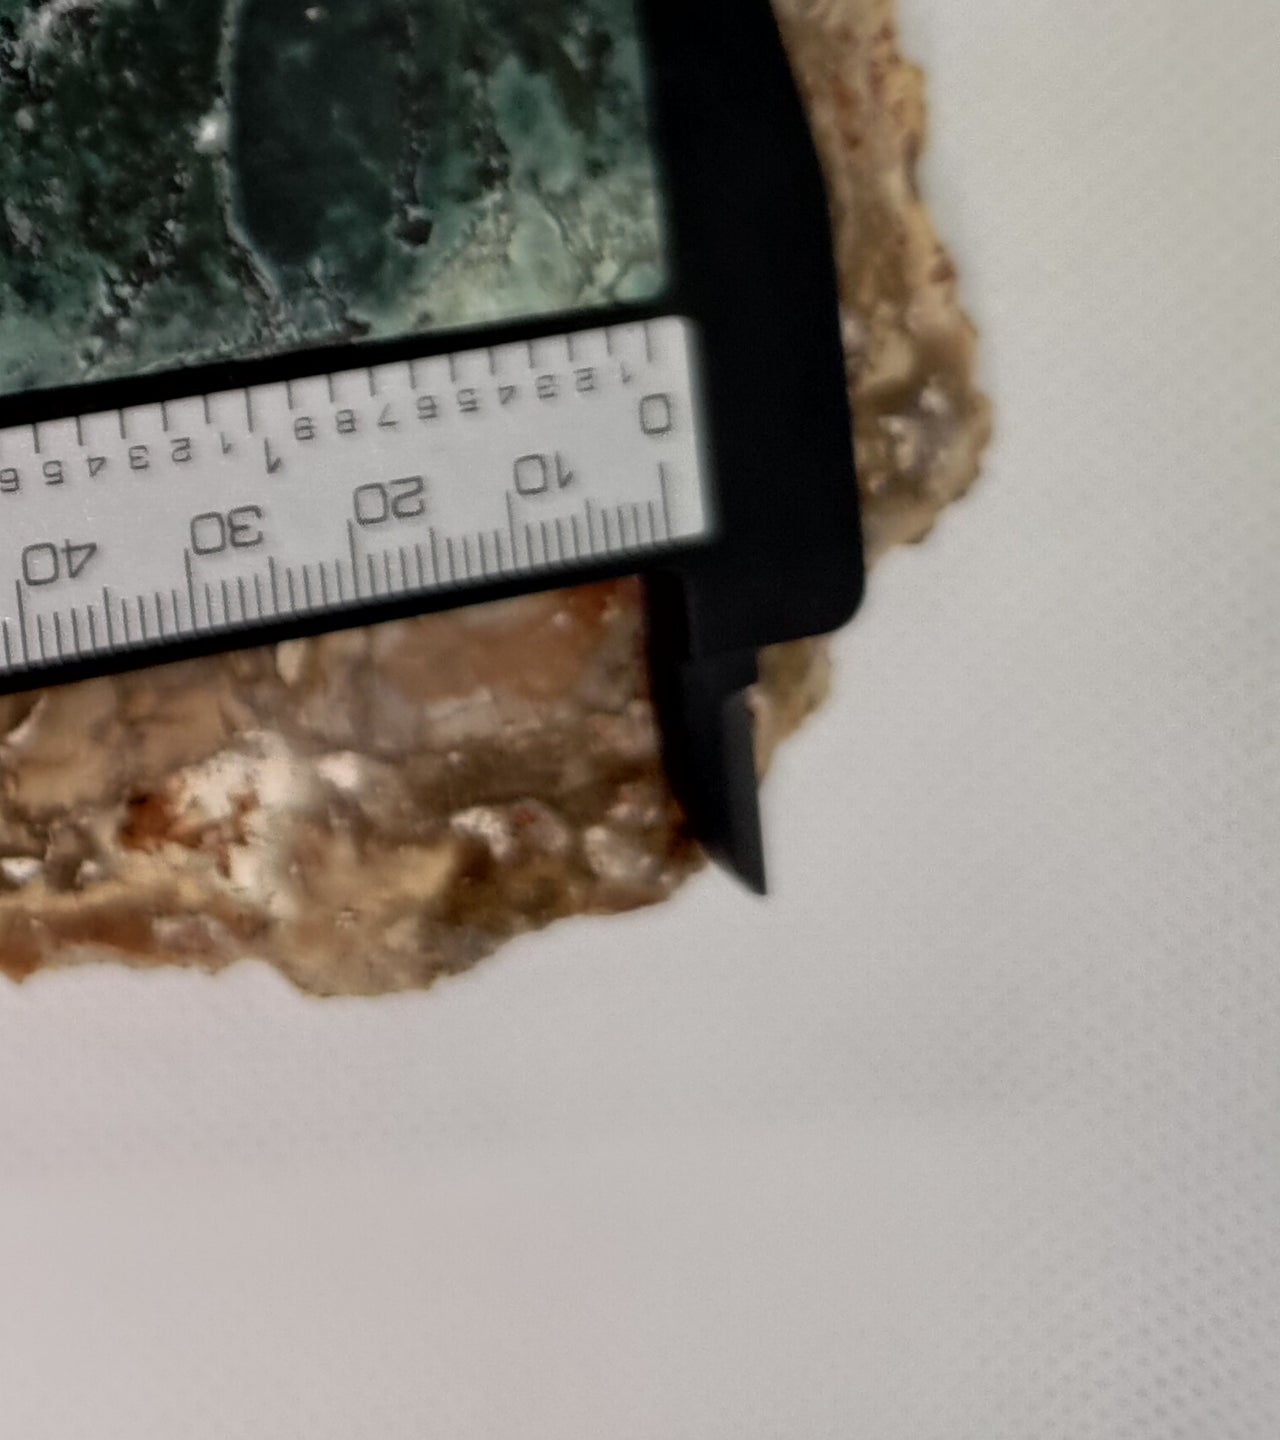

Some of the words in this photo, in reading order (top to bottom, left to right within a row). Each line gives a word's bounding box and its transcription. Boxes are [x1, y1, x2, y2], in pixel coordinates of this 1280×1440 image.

[574, 366, 597, 392] 2
[622, 363, 633, 384] 1
[498, 385, 516, 405] 4
[535, 374, 557, 399] 3
[417, 395, 438, 419] 6
[457, 389, 480, 413] 5
[335, 410, 357, 433] 8
[377, 404, 398, 425] 7
[640, 393, 671, 435] 0
[295, 417, 314, 441] 9
[171, 438, 191, 462] 2
[222, 432, 231, 455] 1
[86, 456, 106, 478] 4
[129, 446, 149, 470] 3
[264, 439, 281, 474] 1
[0, 467, 20, 492] 6
[43, 461, 64, 485] 5
[513, 451, 573, 494] 10
[353, 475, 426, 524] 20
[190, 504, 264, 554] 30
[22, 538, 98, 586] 40
